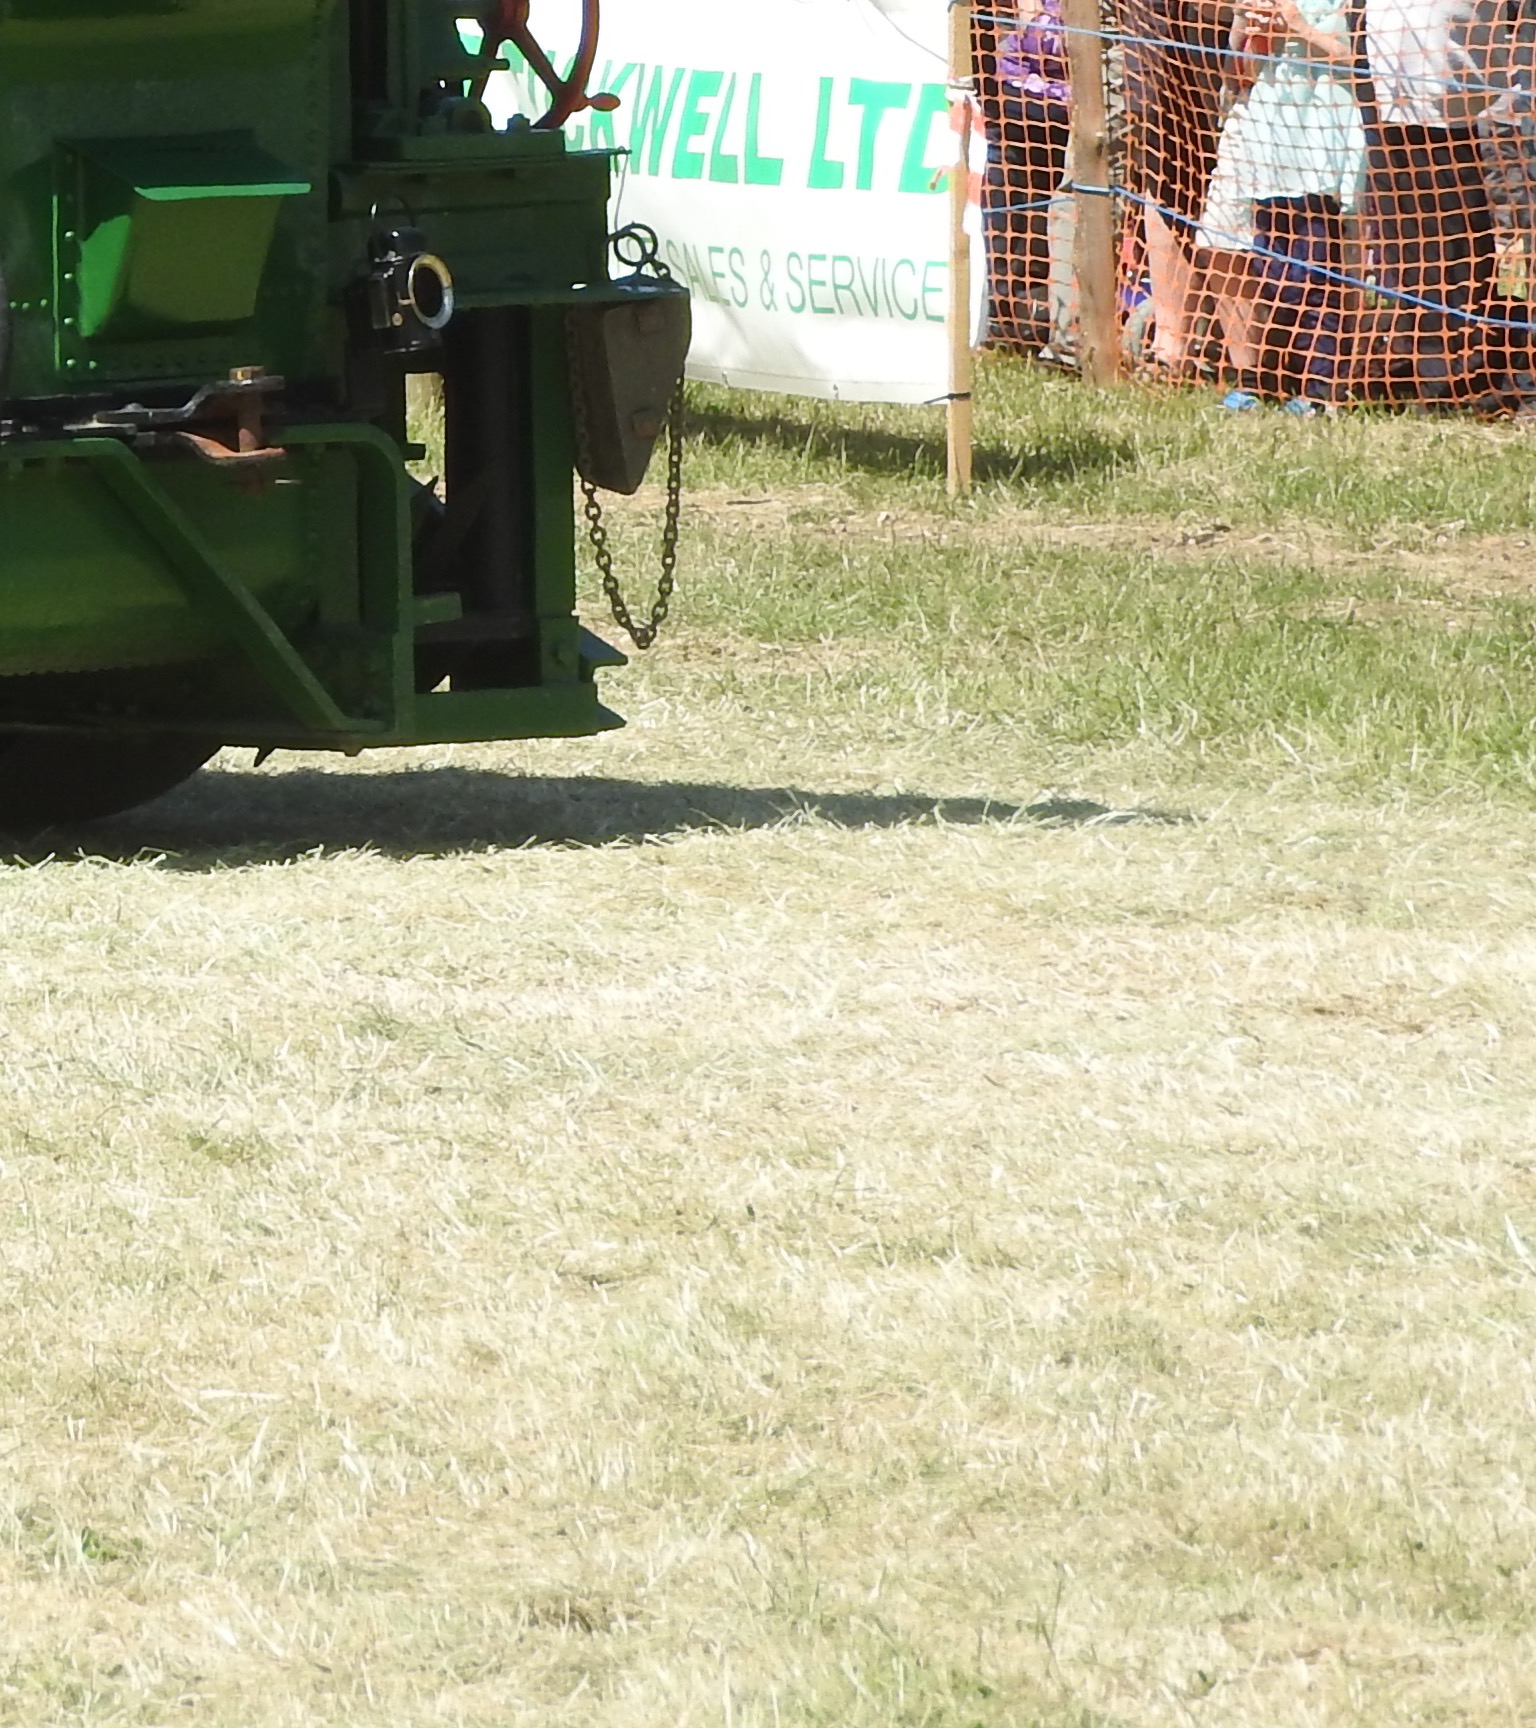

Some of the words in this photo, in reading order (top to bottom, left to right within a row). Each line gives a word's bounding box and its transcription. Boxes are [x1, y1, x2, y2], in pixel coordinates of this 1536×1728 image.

[806, 75, 950, 195] LTD
[665, 238, 749, 309] SALES
[759, 248, 778, 312] &
[785, 251, 951, 323] SERVICE
